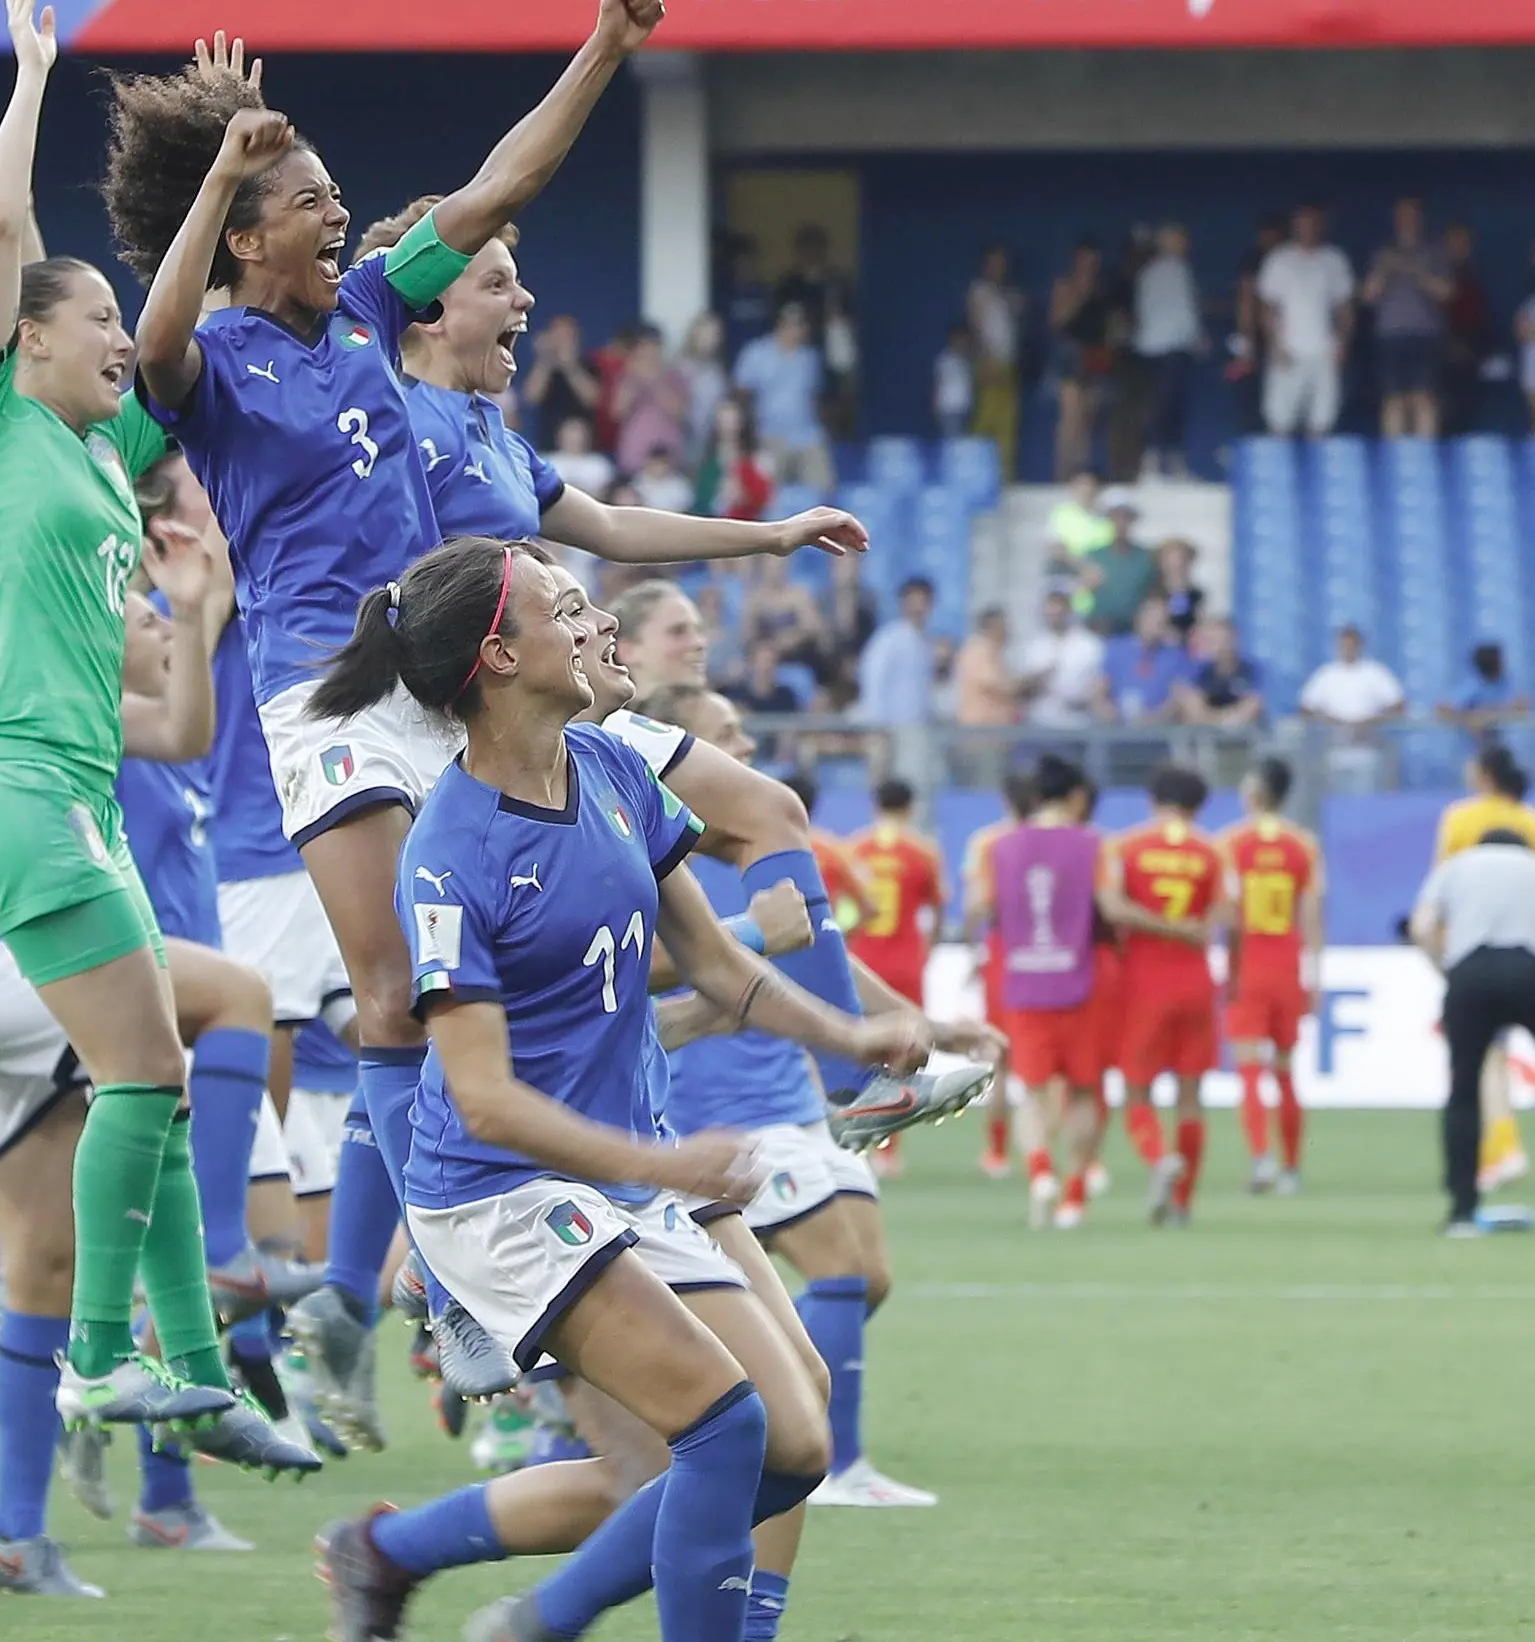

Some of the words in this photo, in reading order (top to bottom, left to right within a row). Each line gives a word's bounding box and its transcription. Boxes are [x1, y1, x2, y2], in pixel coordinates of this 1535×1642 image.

[337, 407, 379, 479] 3
[97, 533, 135, 617] 12
[1152, 877, 1194, 921] 7
[1244, 871, 1296, 935] 10
[582, 910, 645, 1013] 11
